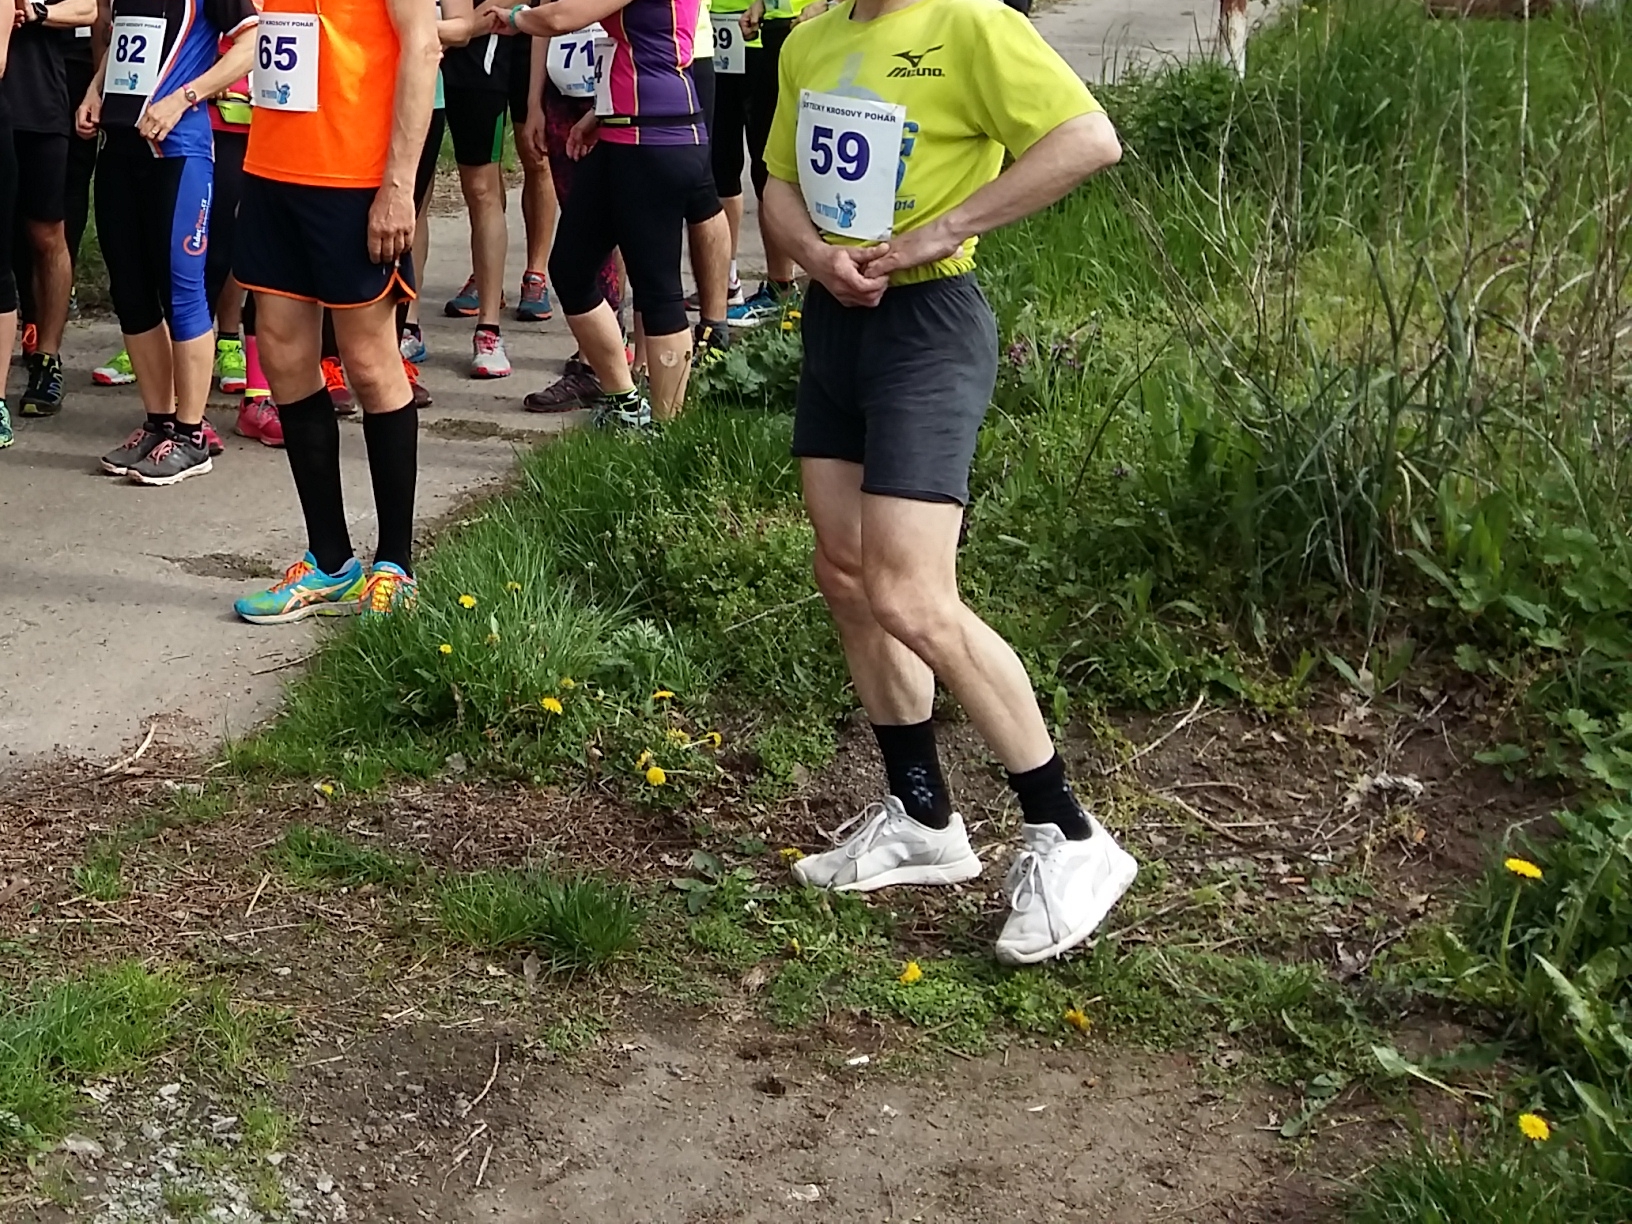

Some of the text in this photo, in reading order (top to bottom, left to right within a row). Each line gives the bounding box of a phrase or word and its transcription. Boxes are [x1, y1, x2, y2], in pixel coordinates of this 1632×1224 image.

[116, 34, 147, 63] 82
[258, 35, 298, 71] 65
[560, 40, 595, 69] 71
[810, 125, 870, 181] 59
